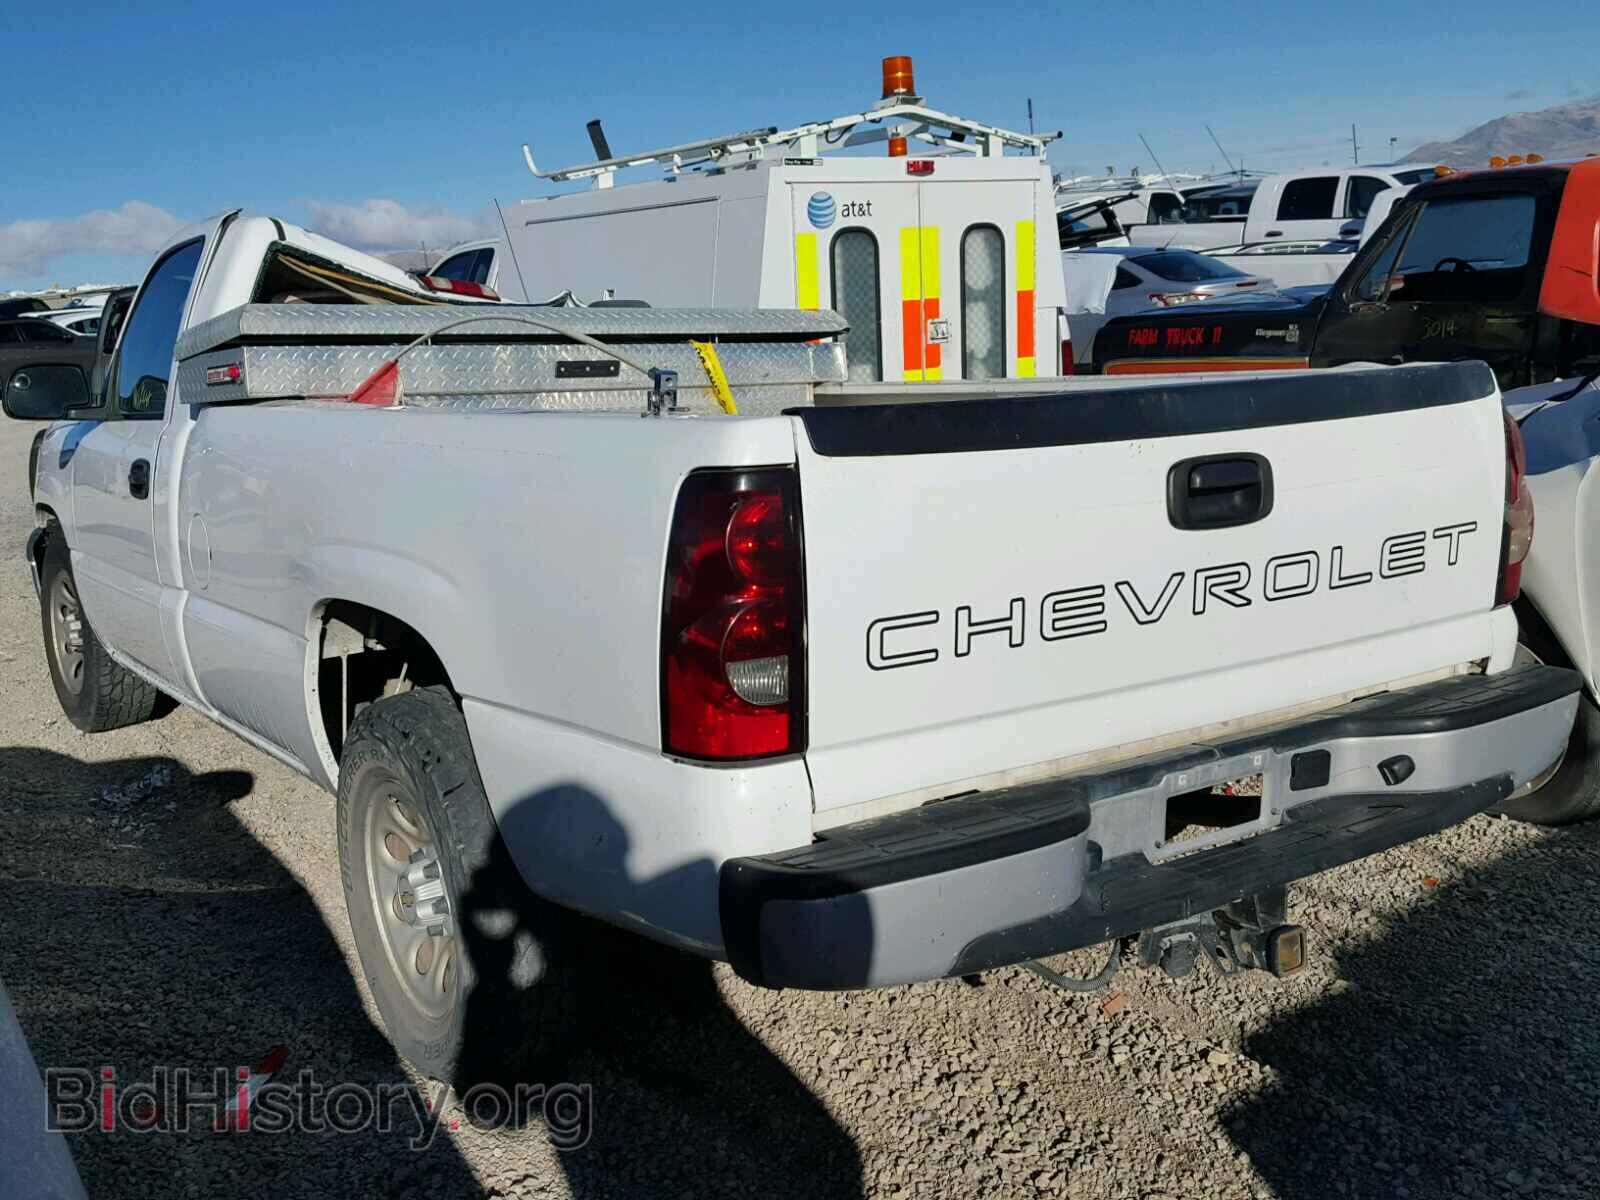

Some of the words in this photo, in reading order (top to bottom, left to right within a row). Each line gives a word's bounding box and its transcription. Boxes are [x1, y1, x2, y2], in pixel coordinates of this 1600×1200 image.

[841, 200, 872, 217] at&t
[1129, 327, 1159, 345] FARM
[1167, 327, 1204, 345] TRUCK
[1422, 316, 1458, 339] 3014
[866, 522, 1477, 670] CHEVROLET
